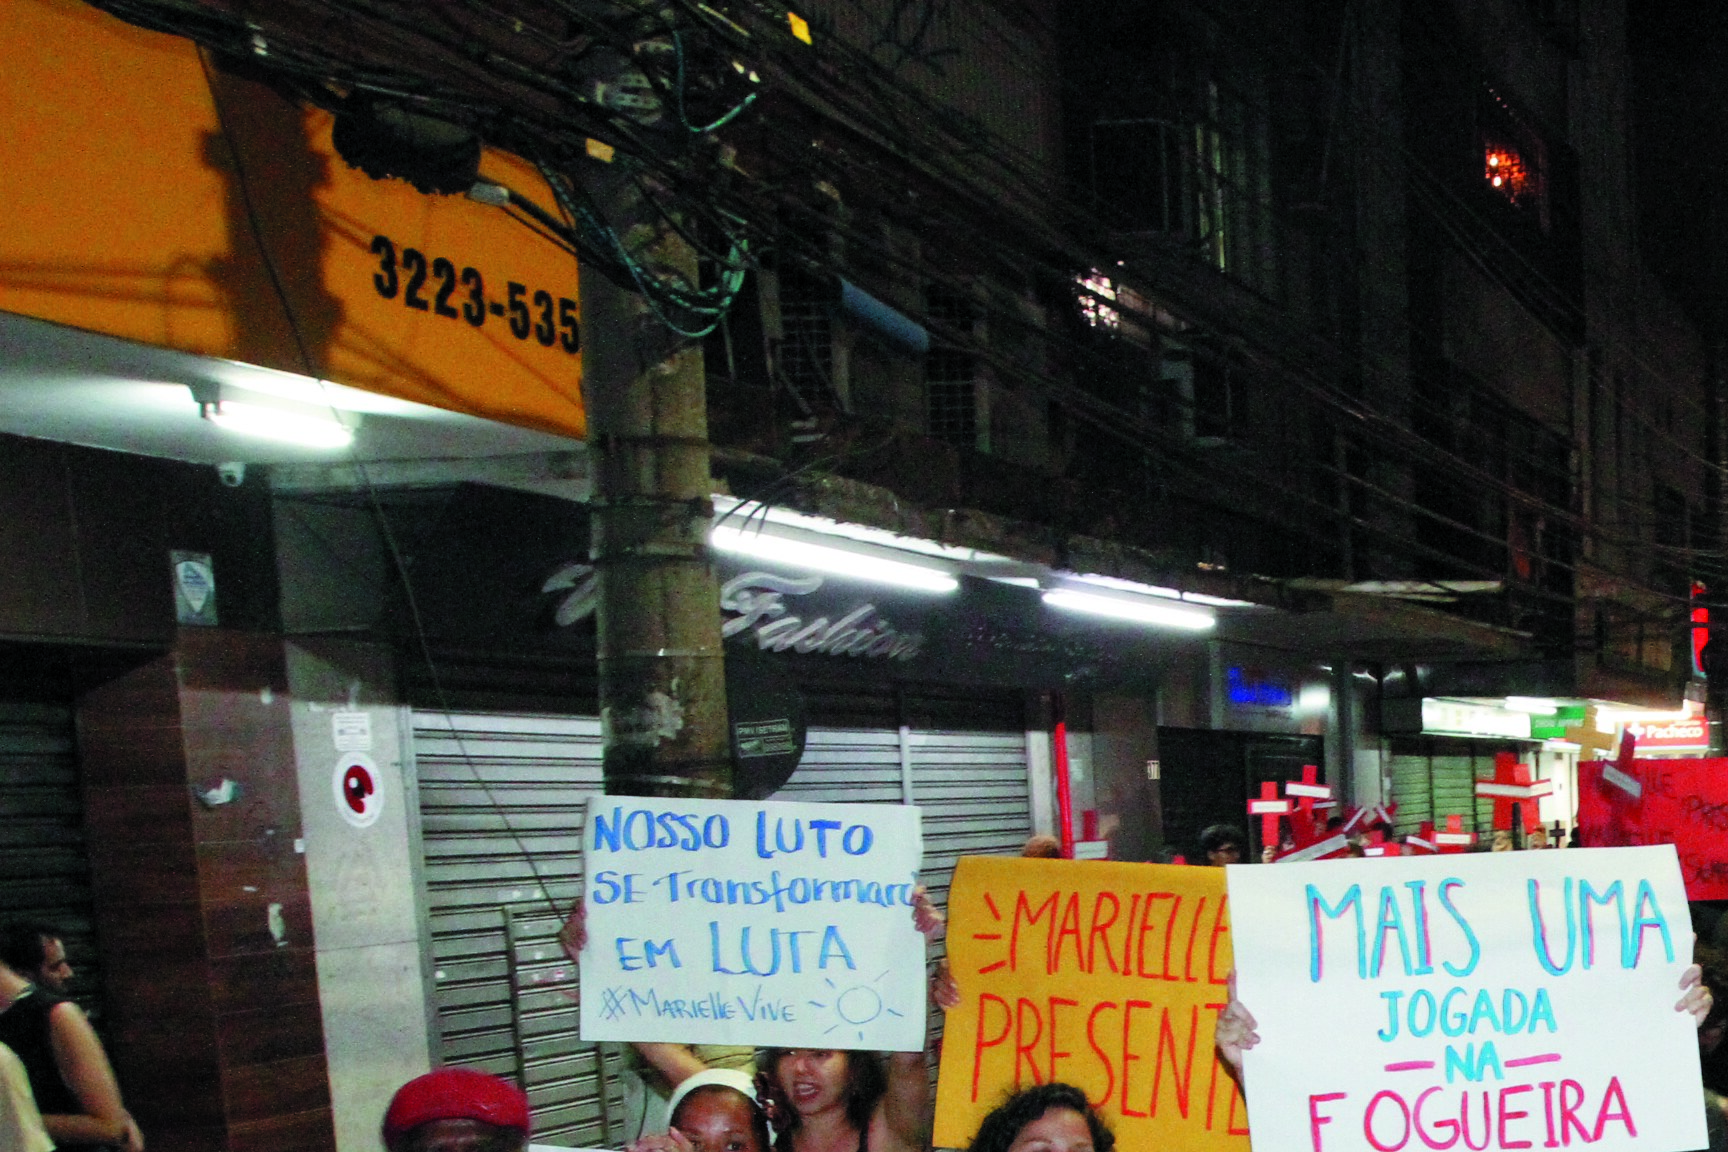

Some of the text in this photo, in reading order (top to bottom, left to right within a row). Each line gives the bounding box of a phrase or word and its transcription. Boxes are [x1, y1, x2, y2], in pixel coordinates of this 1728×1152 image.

[1646, 724, 1704, 739] Pacheco
[593, 806, 875, 858] NOSSO LUTO
[592, 870, 648, 905] SE
[615, 920, 857, 976] EM LUTA
[1305, 876, 1675, 983] MAIS UMA
[1377, 986, 1558, 1042] JOGADA
[1444, 1040, 1504, 1084] NA
